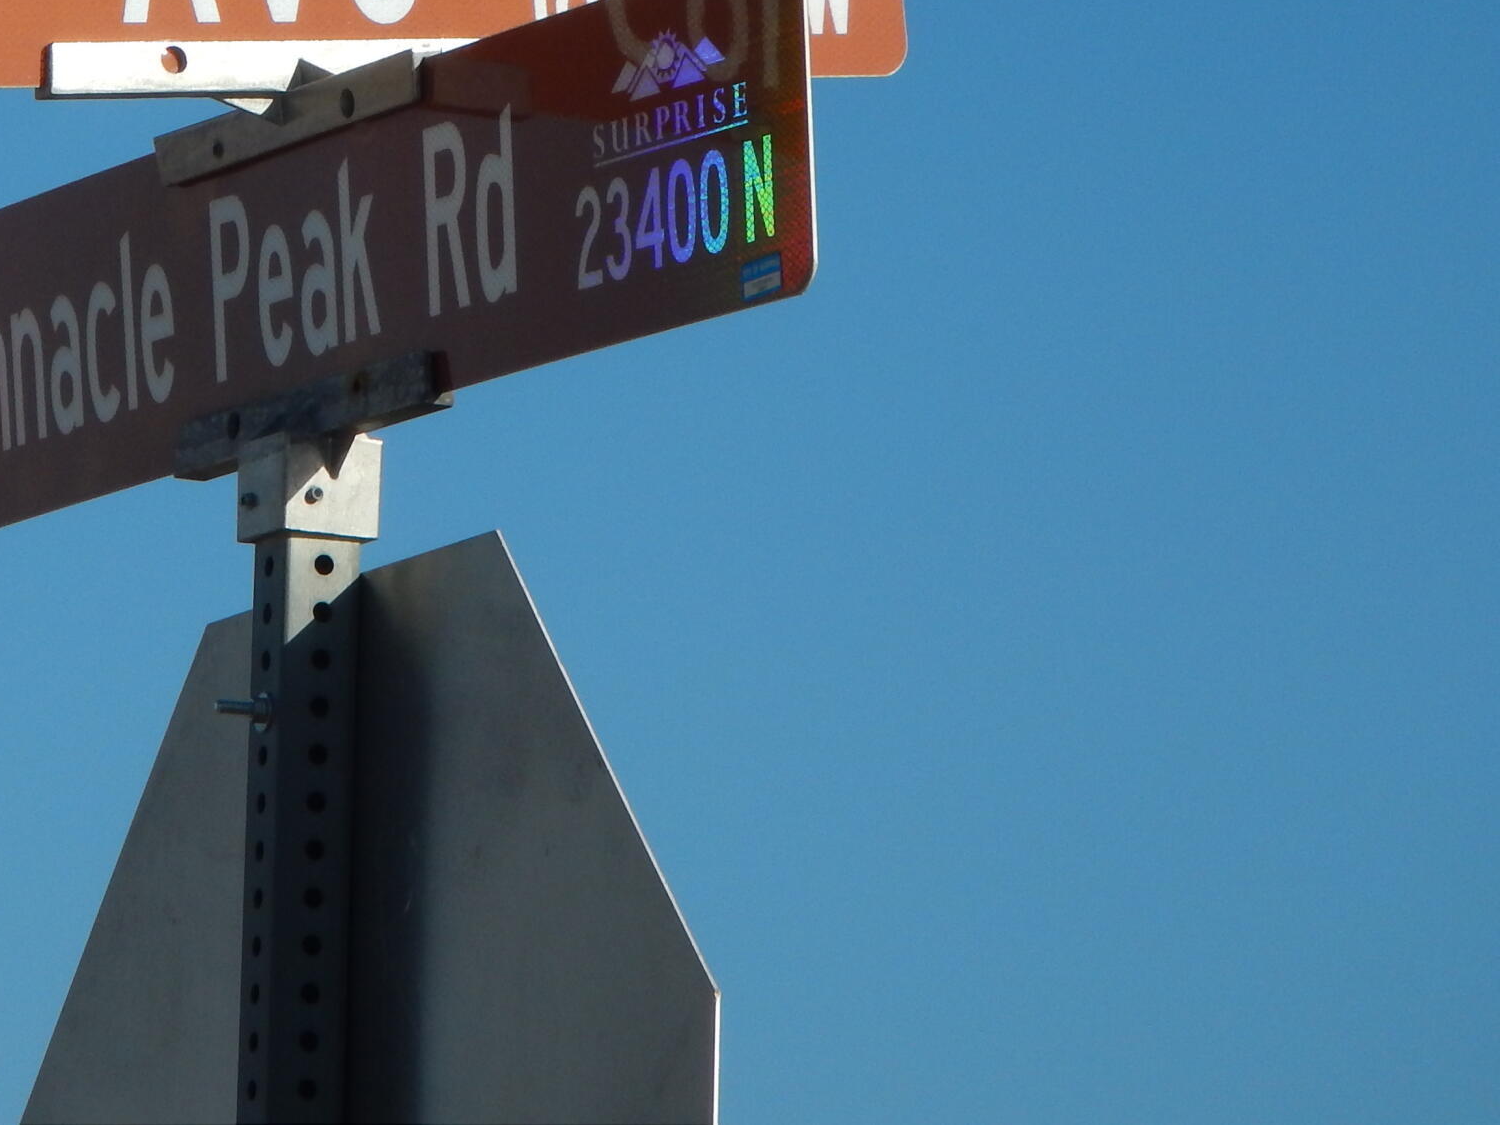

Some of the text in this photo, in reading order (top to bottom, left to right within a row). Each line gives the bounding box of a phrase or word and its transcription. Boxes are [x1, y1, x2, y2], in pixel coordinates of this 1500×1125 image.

[592, 81, 749, 159] SURPRISE
[208, 156, 381, 385] Peak
[421, 101, 519, 318] Rd
[575, 133, 776, 291] 23400 N
